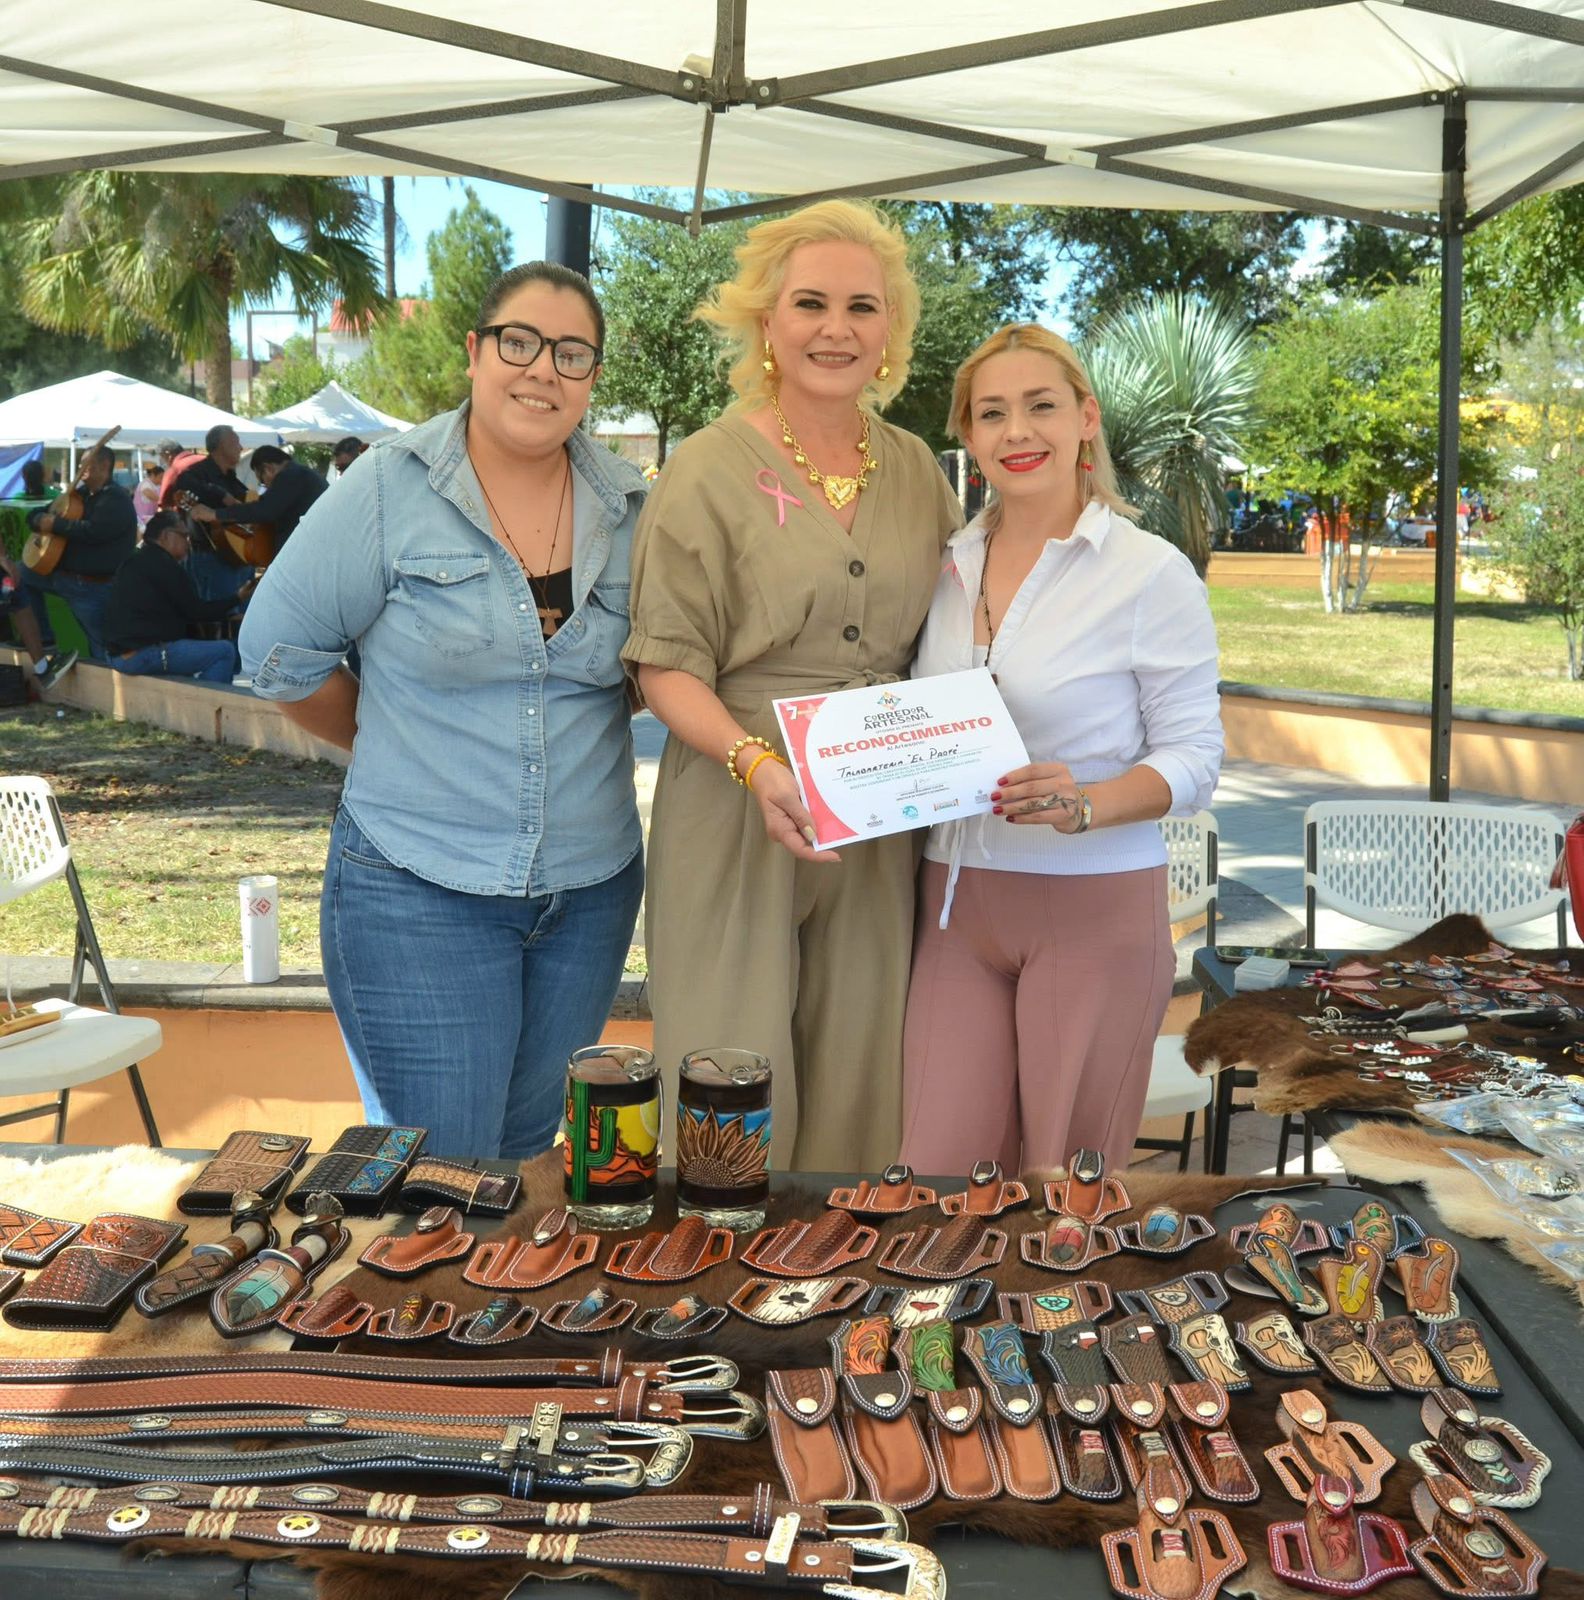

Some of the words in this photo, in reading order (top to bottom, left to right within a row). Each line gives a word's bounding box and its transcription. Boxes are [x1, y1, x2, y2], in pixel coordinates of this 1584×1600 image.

[863, 705, 925, 723] CORREDOR
[863, 711, 934, 731] ARTESANAL
[817, 716, 993, 759] RECONOCIMIENTO
